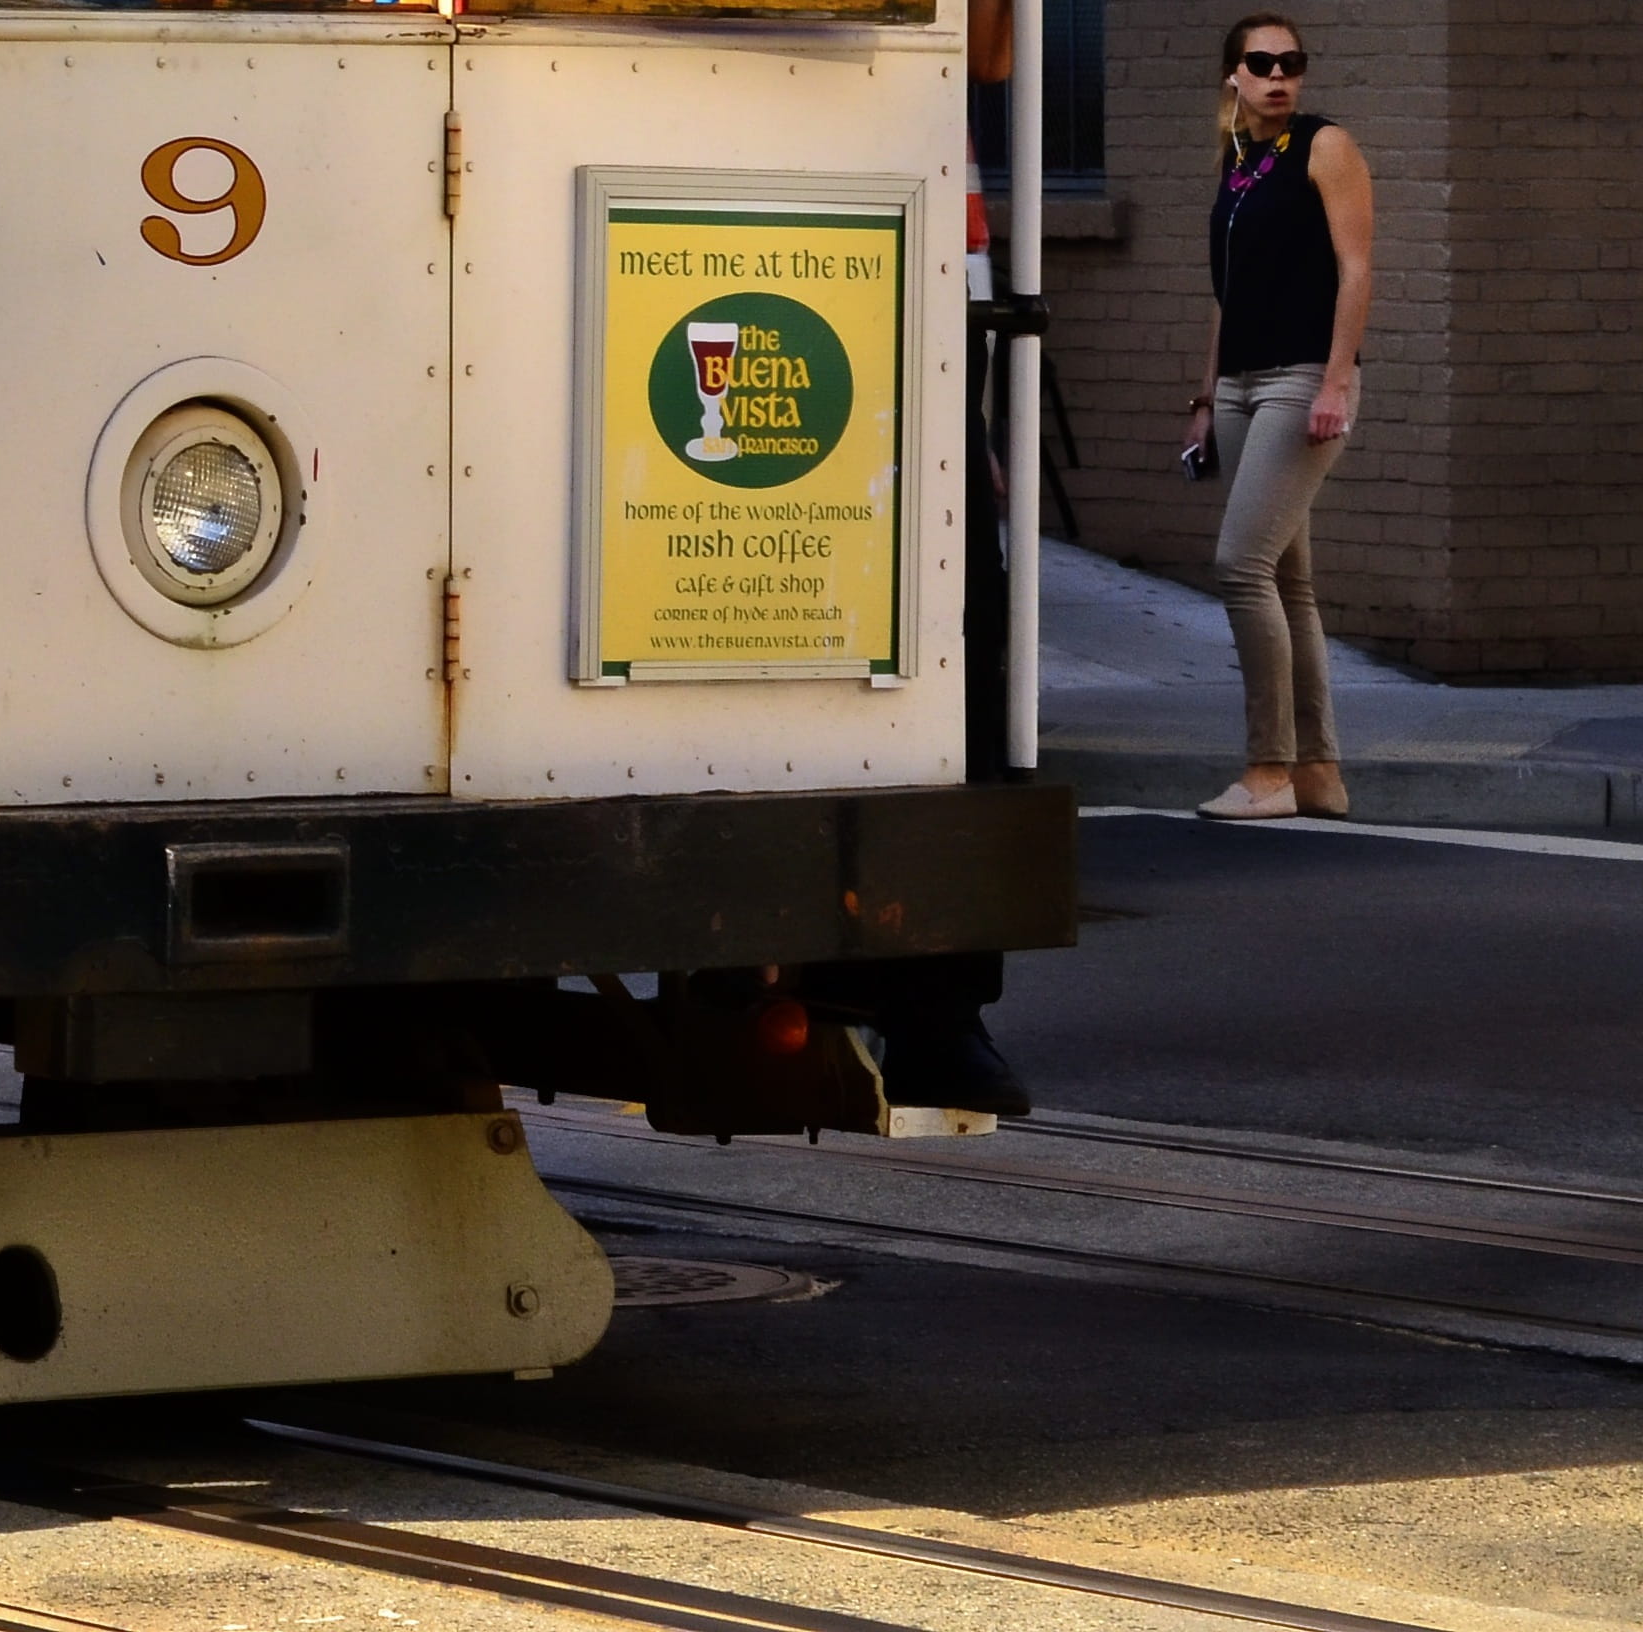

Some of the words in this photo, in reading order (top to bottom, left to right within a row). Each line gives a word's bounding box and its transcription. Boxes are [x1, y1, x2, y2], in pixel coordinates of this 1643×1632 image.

[140, 136, 266, 266] 9
[620, 249, 692, 276] meet
[703, 252, 745, 277] me
[754, 251, 782, 279] at
[791, 249, 836, 279] the
[740, 325, 781, 351] the
[625, 501, 677, 520] home
[683, 501, 703, 524] of
[710, 501, 741, 520] the
[723, 575, 734, 593] &
[780, 574, 824, 598] shop
[713, 606, 730, 625] of
[773, 607, 798, 621] and
